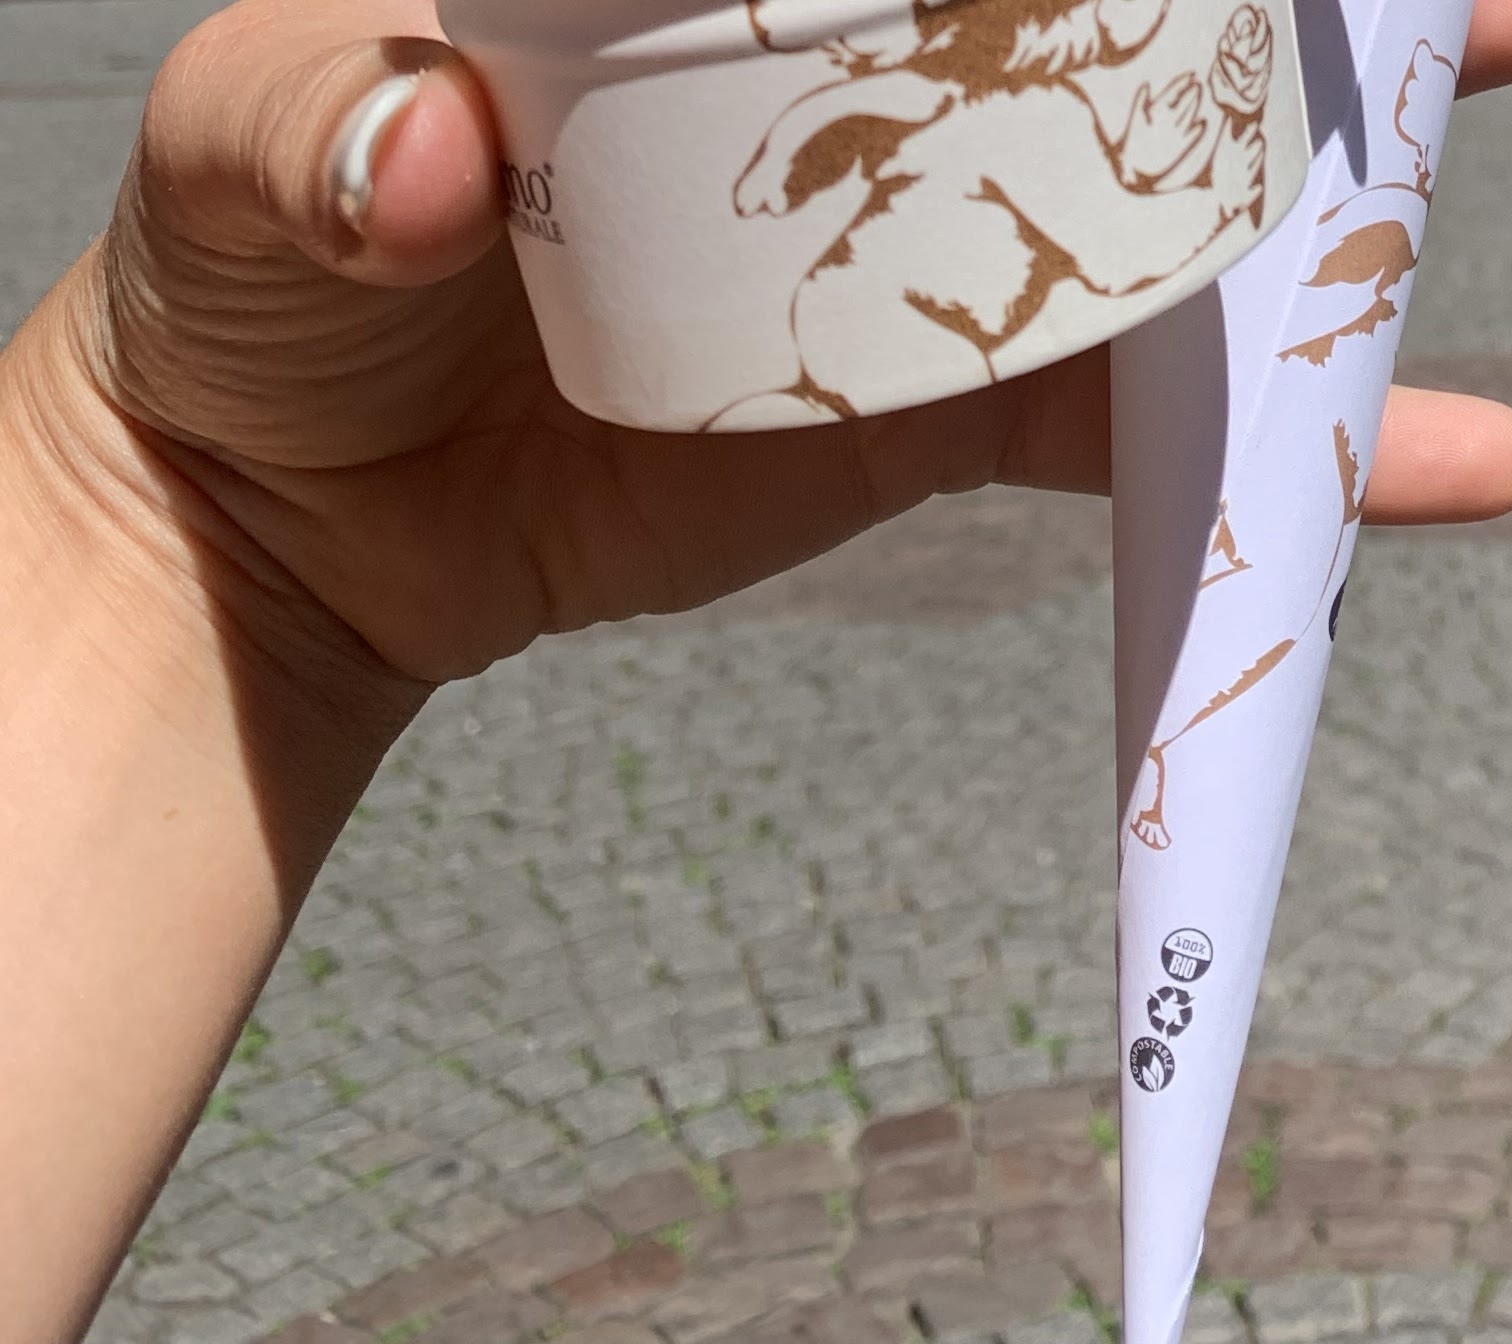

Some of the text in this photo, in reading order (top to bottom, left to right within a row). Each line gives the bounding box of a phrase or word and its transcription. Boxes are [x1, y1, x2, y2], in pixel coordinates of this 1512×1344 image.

[506, 163, 553, 215] no
[1173, 935, 1206, 955] 100%
[1168, 952, 1198, 980] BIO
[1131, 1039, 1174, 1082] COMPOSTABLE
